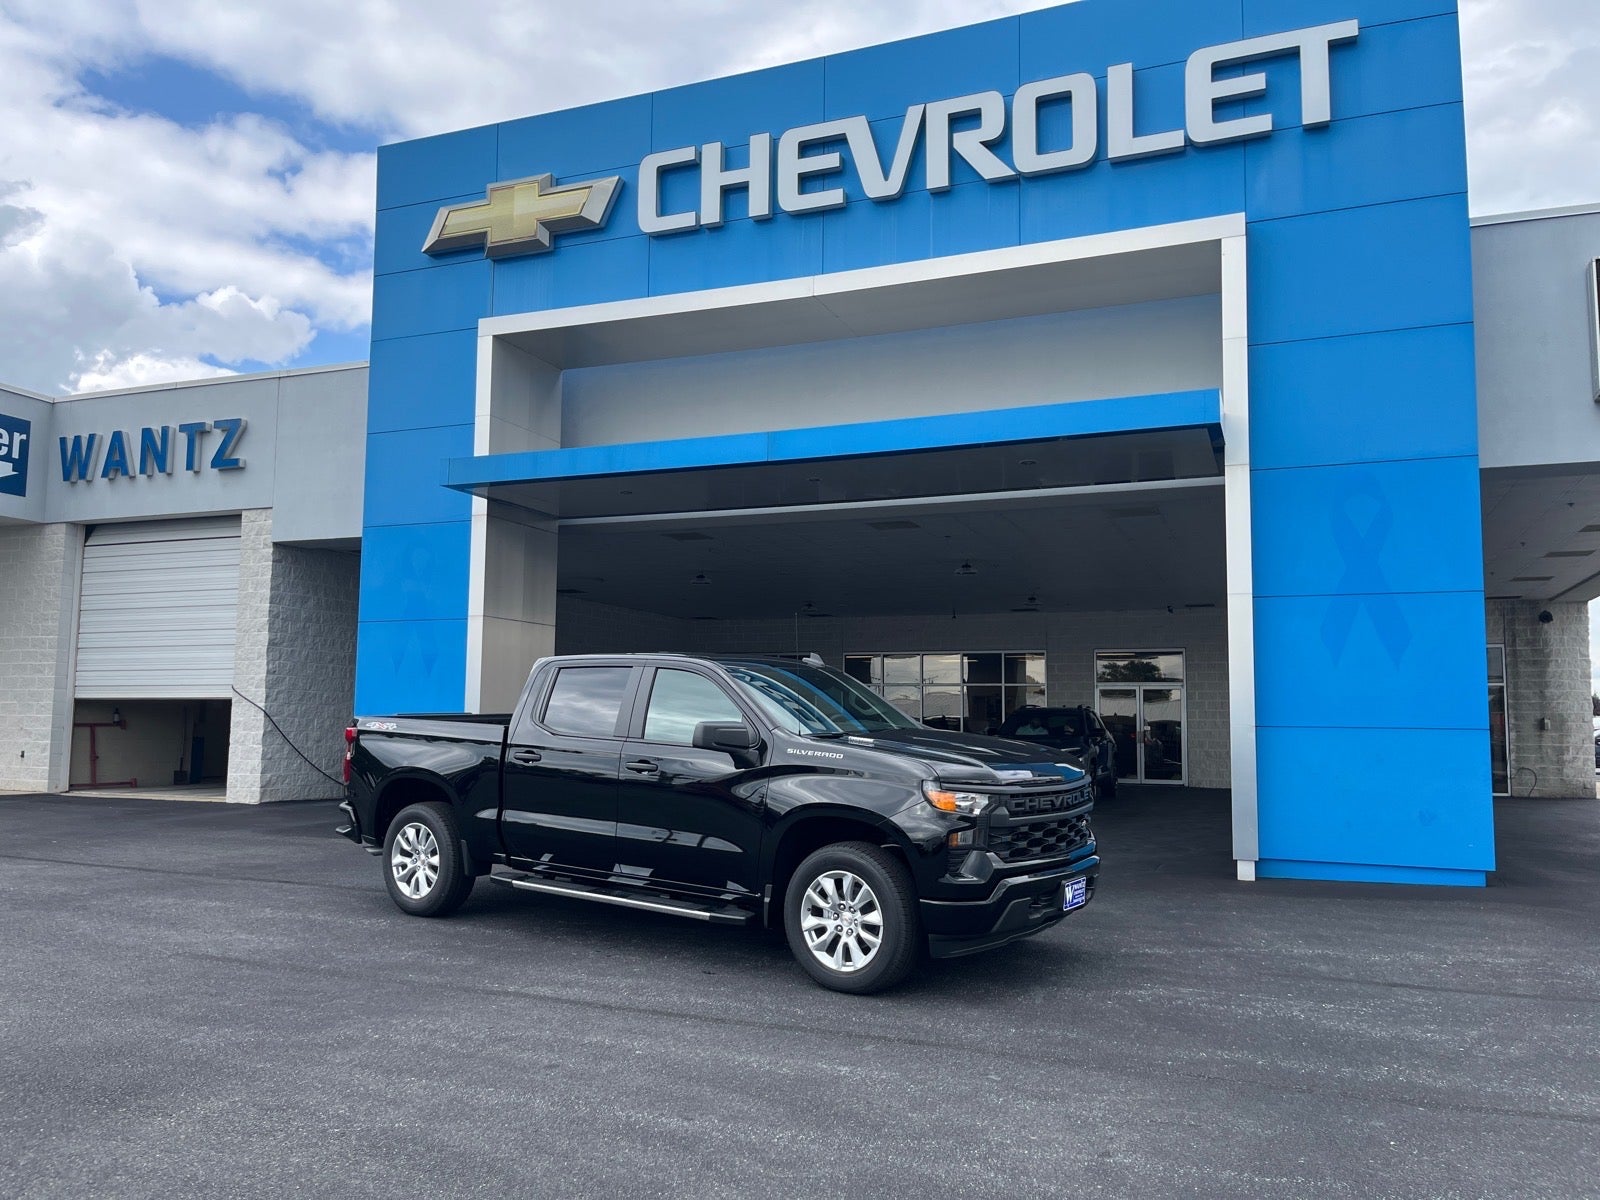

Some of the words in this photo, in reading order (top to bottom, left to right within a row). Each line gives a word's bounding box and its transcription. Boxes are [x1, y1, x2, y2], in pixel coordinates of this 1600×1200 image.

[637, 19, 1359, 236] CHEVROLET
[59, 418, 248, 482] WANTZ
[786, 748, 844, 759] SILVERADO
[1009, 788, 1092, 811] CHEVROLE
